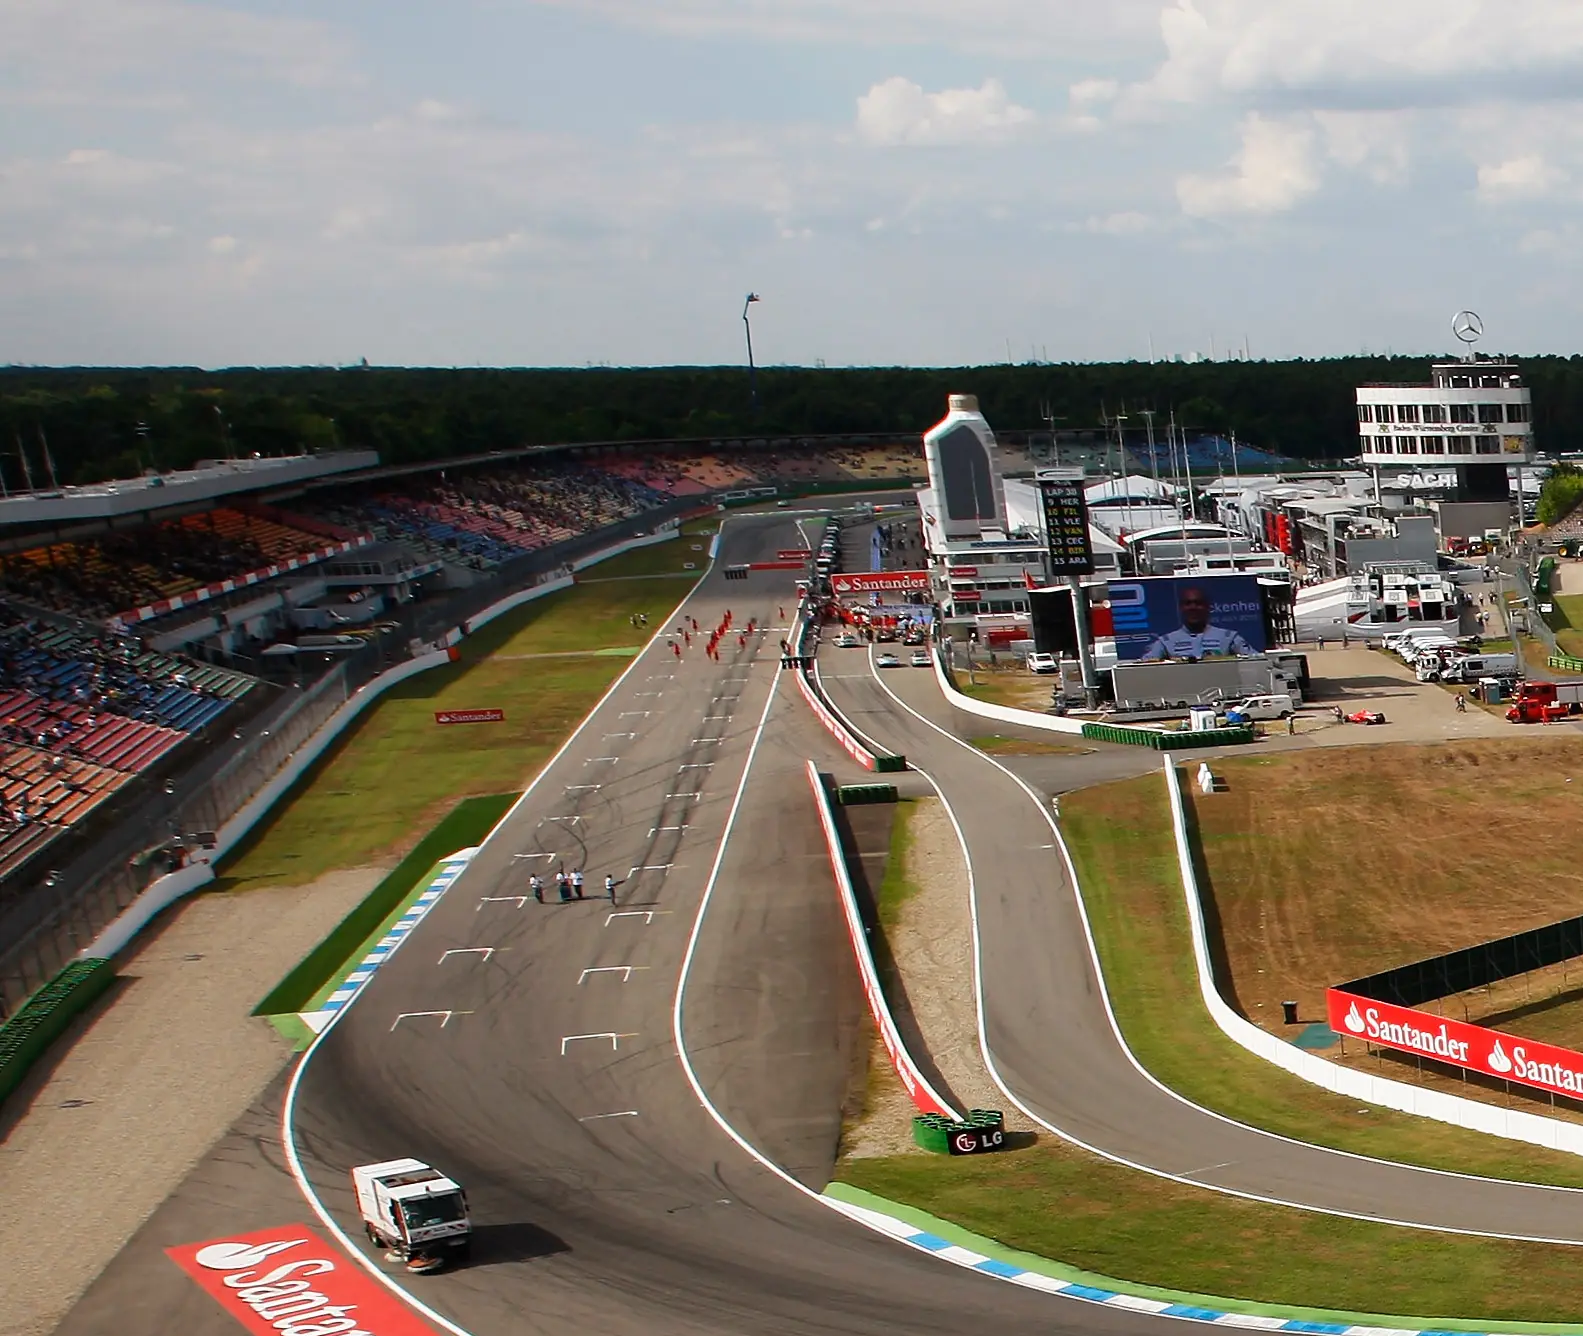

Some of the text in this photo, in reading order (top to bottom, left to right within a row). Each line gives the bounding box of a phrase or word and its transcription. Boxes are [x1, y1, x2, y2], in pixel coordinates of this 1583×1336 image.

[1066, 537, 1084, 545] CEC
[853, 576, 926, 591] Santander
[1365, 1006, 1469, 1063] Santander
[981, 1131, 1002, 1147] LG
